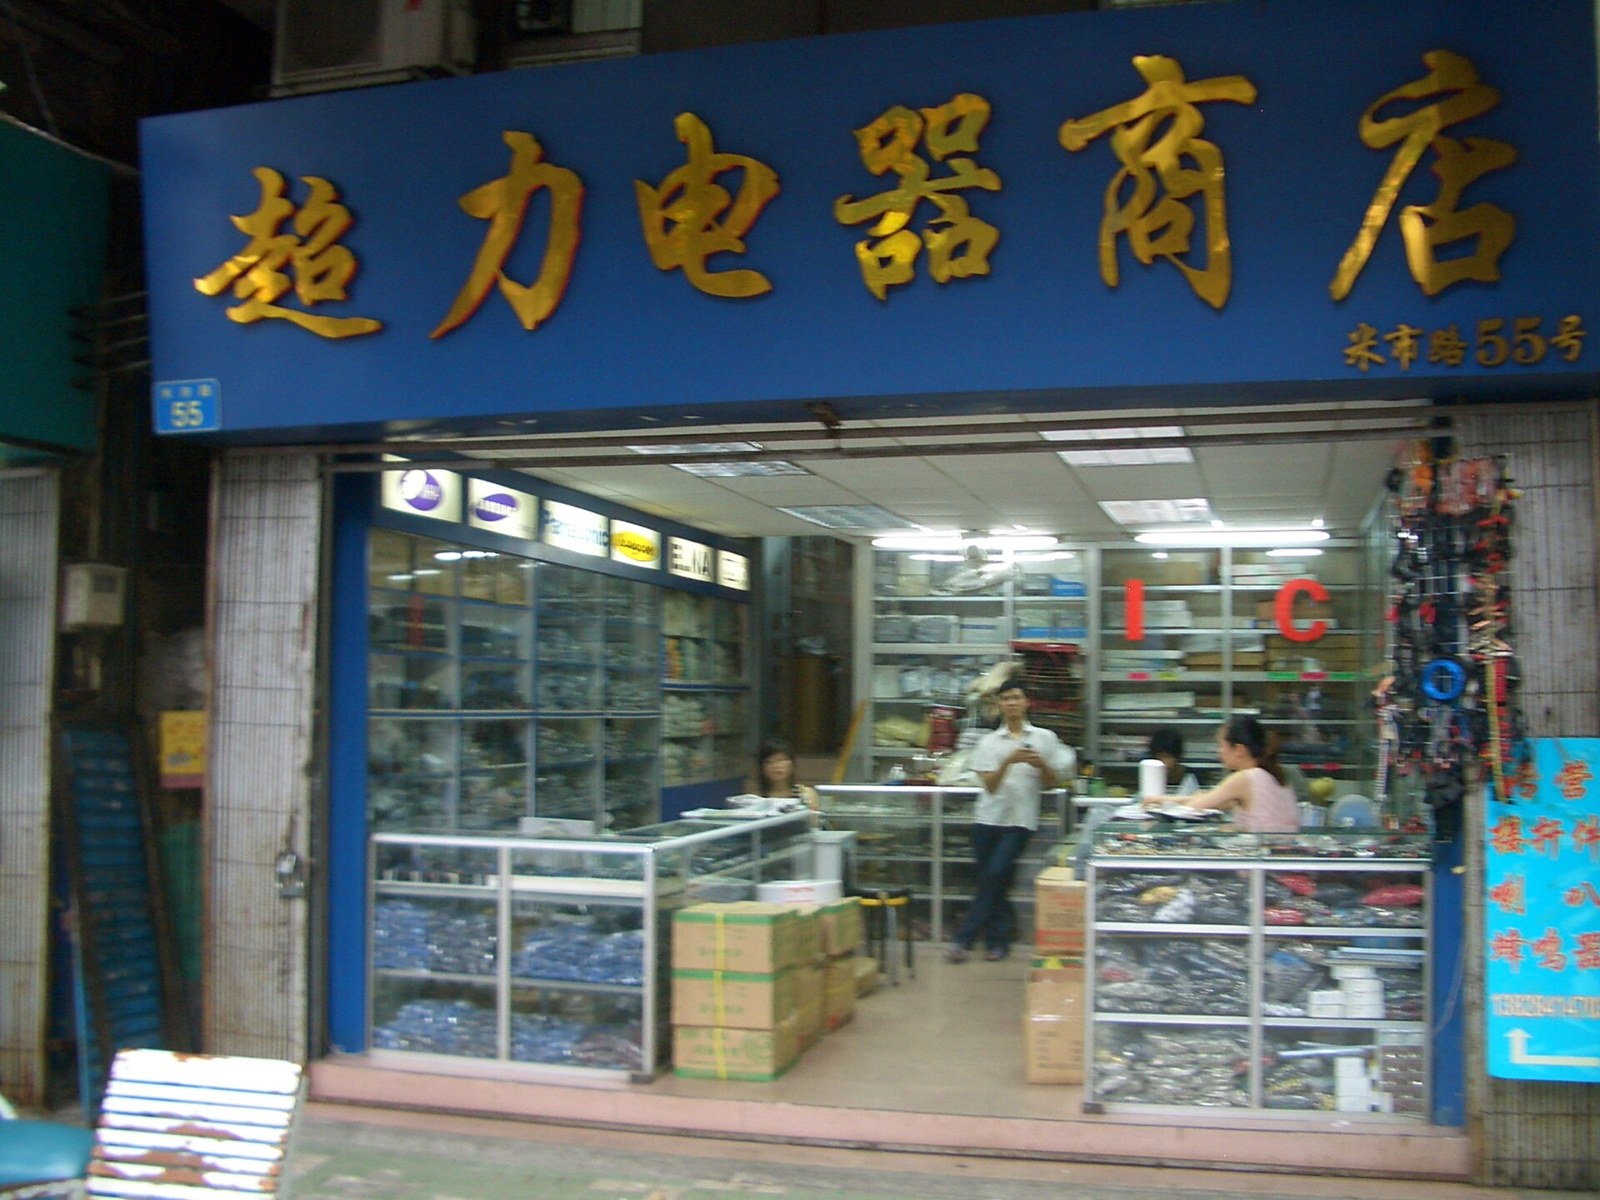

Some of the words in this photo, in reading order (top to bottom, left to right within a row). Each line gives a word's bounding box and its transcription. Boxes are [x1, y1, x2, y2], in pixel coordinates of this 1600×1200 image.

[193, 48, 1520, 341] 超力电器商店
[171, 401, 204, 428] 55
